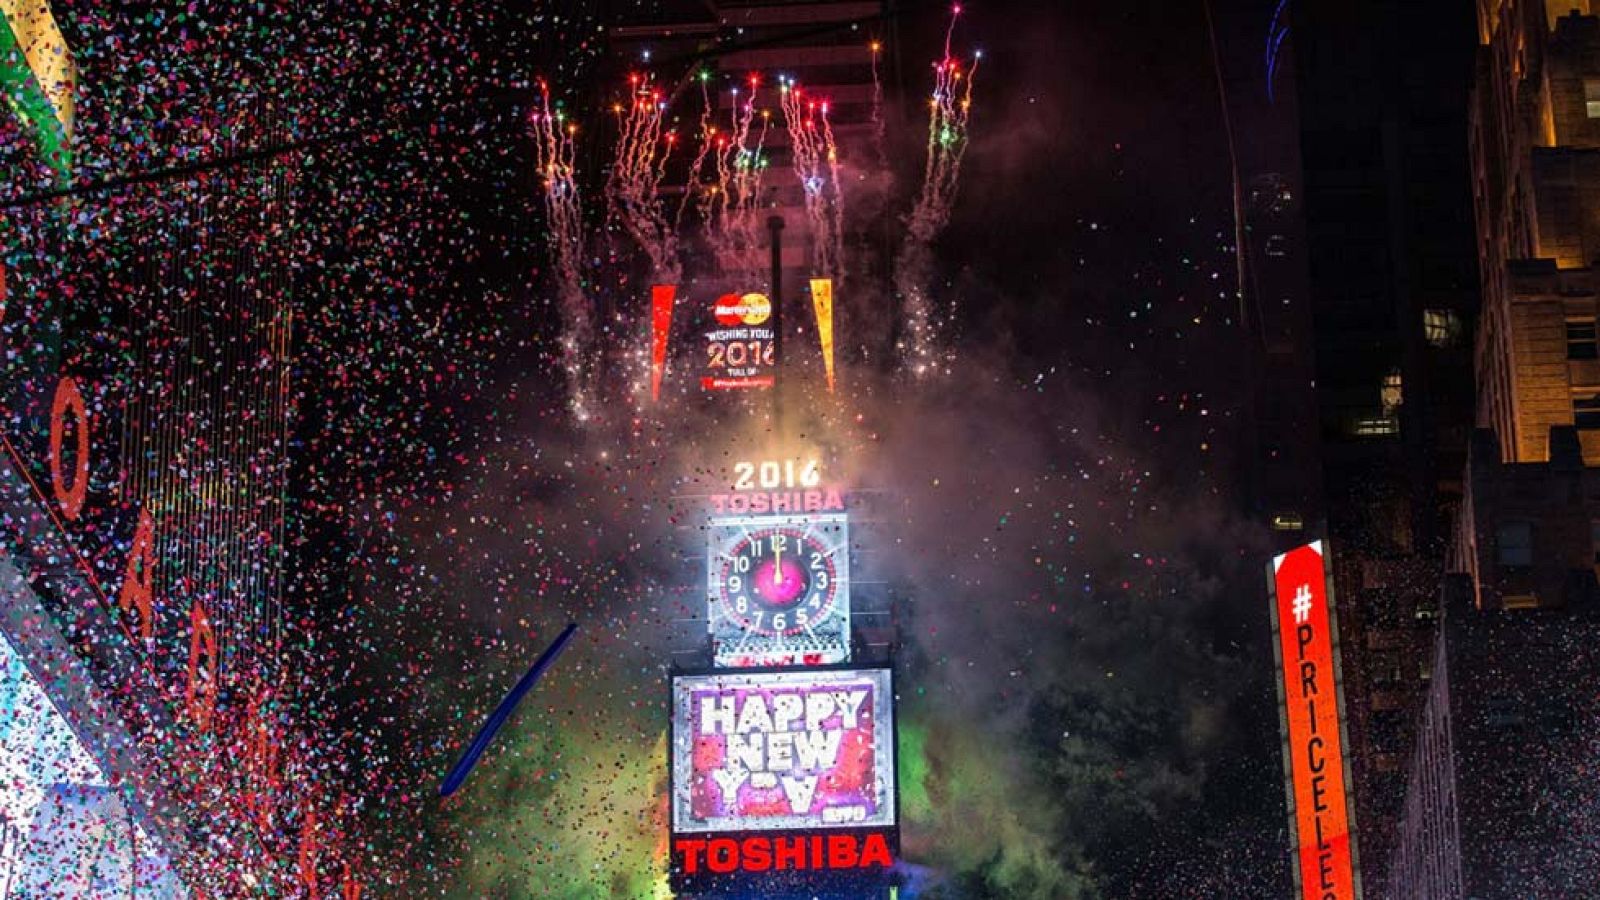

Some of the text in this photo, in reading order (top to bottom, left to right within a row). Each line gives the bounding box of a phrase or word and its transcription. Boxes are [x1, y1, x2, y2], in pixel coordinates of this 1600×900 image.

[734, 459, 820, 490] 2016
[710, 484, 845, 514] TOSHIBA
[750, 540, 762, 557] 11
[796, 538, 803, 555] 1
[729, 556, 749, 573] 10
[811, 552, 823, 569] 2
[728, 576, 741, 593] 9
[816, 571, 827, 589] 3
[736, 596, 747, 614] 8
[809, 592, 820, 609] 4
[752, 610, 763, 628] 7
[773, 613, 786, 630] 6
[796, 608, 808, 625] 5
[700, 690, 868, 735] HAPPY
[725, 729, 842, 772] NEW
[675, 833, 892, 873] TOSHIBA
